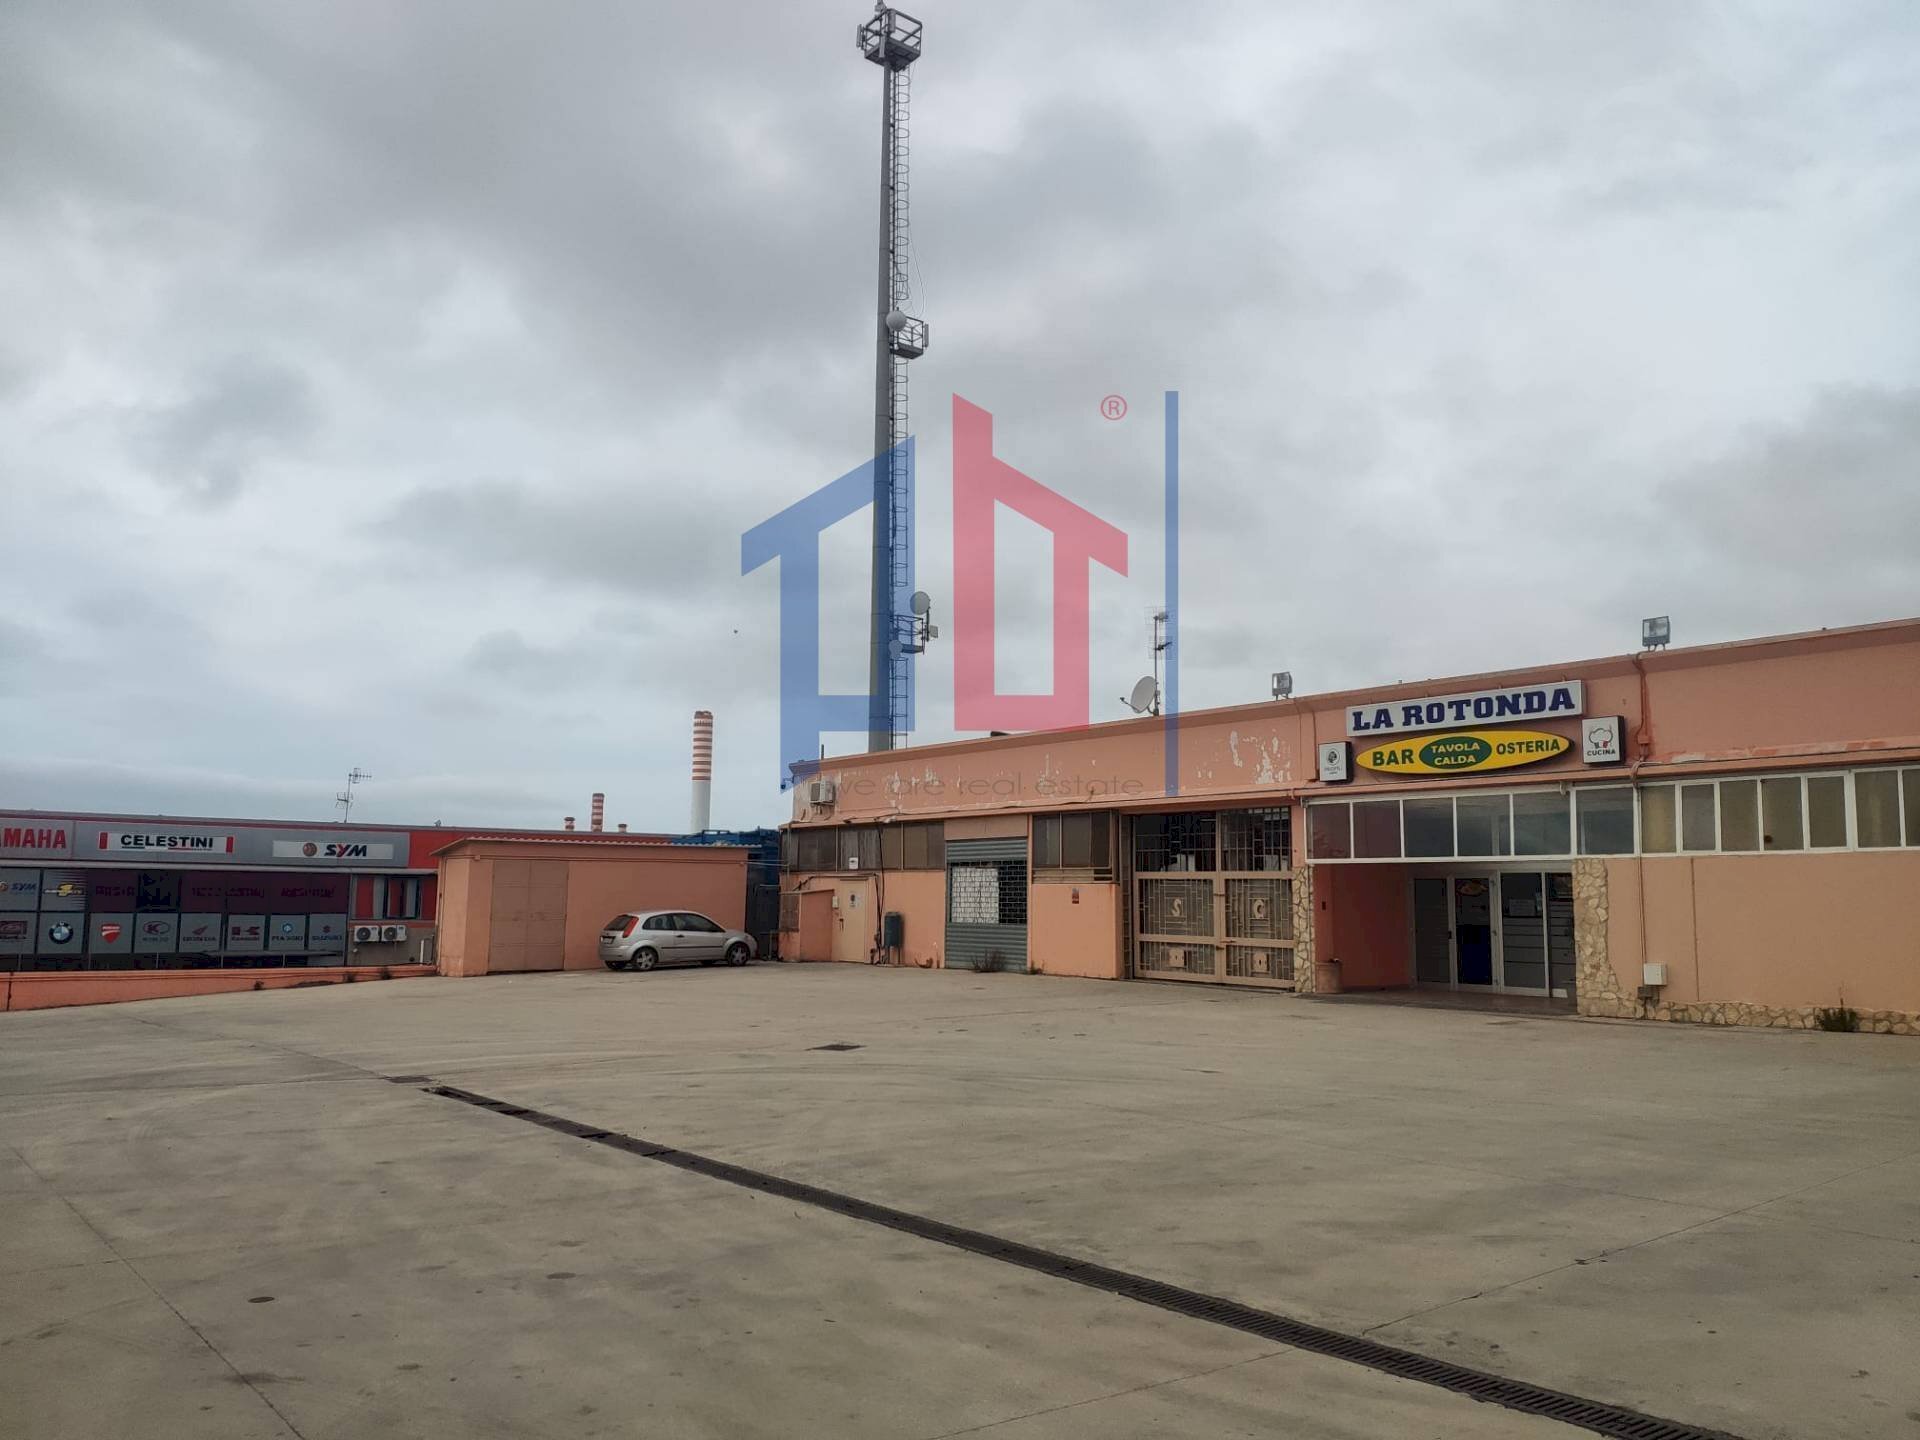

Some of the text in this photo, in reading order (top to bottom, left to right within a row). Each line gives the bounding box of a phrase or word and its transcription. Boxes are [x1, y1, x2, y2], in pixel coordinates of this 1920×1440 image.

[1352, 687, 1575, 731] LA ROTONDA
[1431, 741, 1481, 754] TAVOLA
[1495, 738, 1560, 756] OSTERIA
[1586, 748, 1616, 757] CUCINA
[1372, 748, 1414, 767] BAR
[1433, 754, 1476, 766] CALDA
[0, 827, 66, 849] MAHA
[120, 834, 213, 848] CELESTINI
[324, 843, 367, 857] SYM
